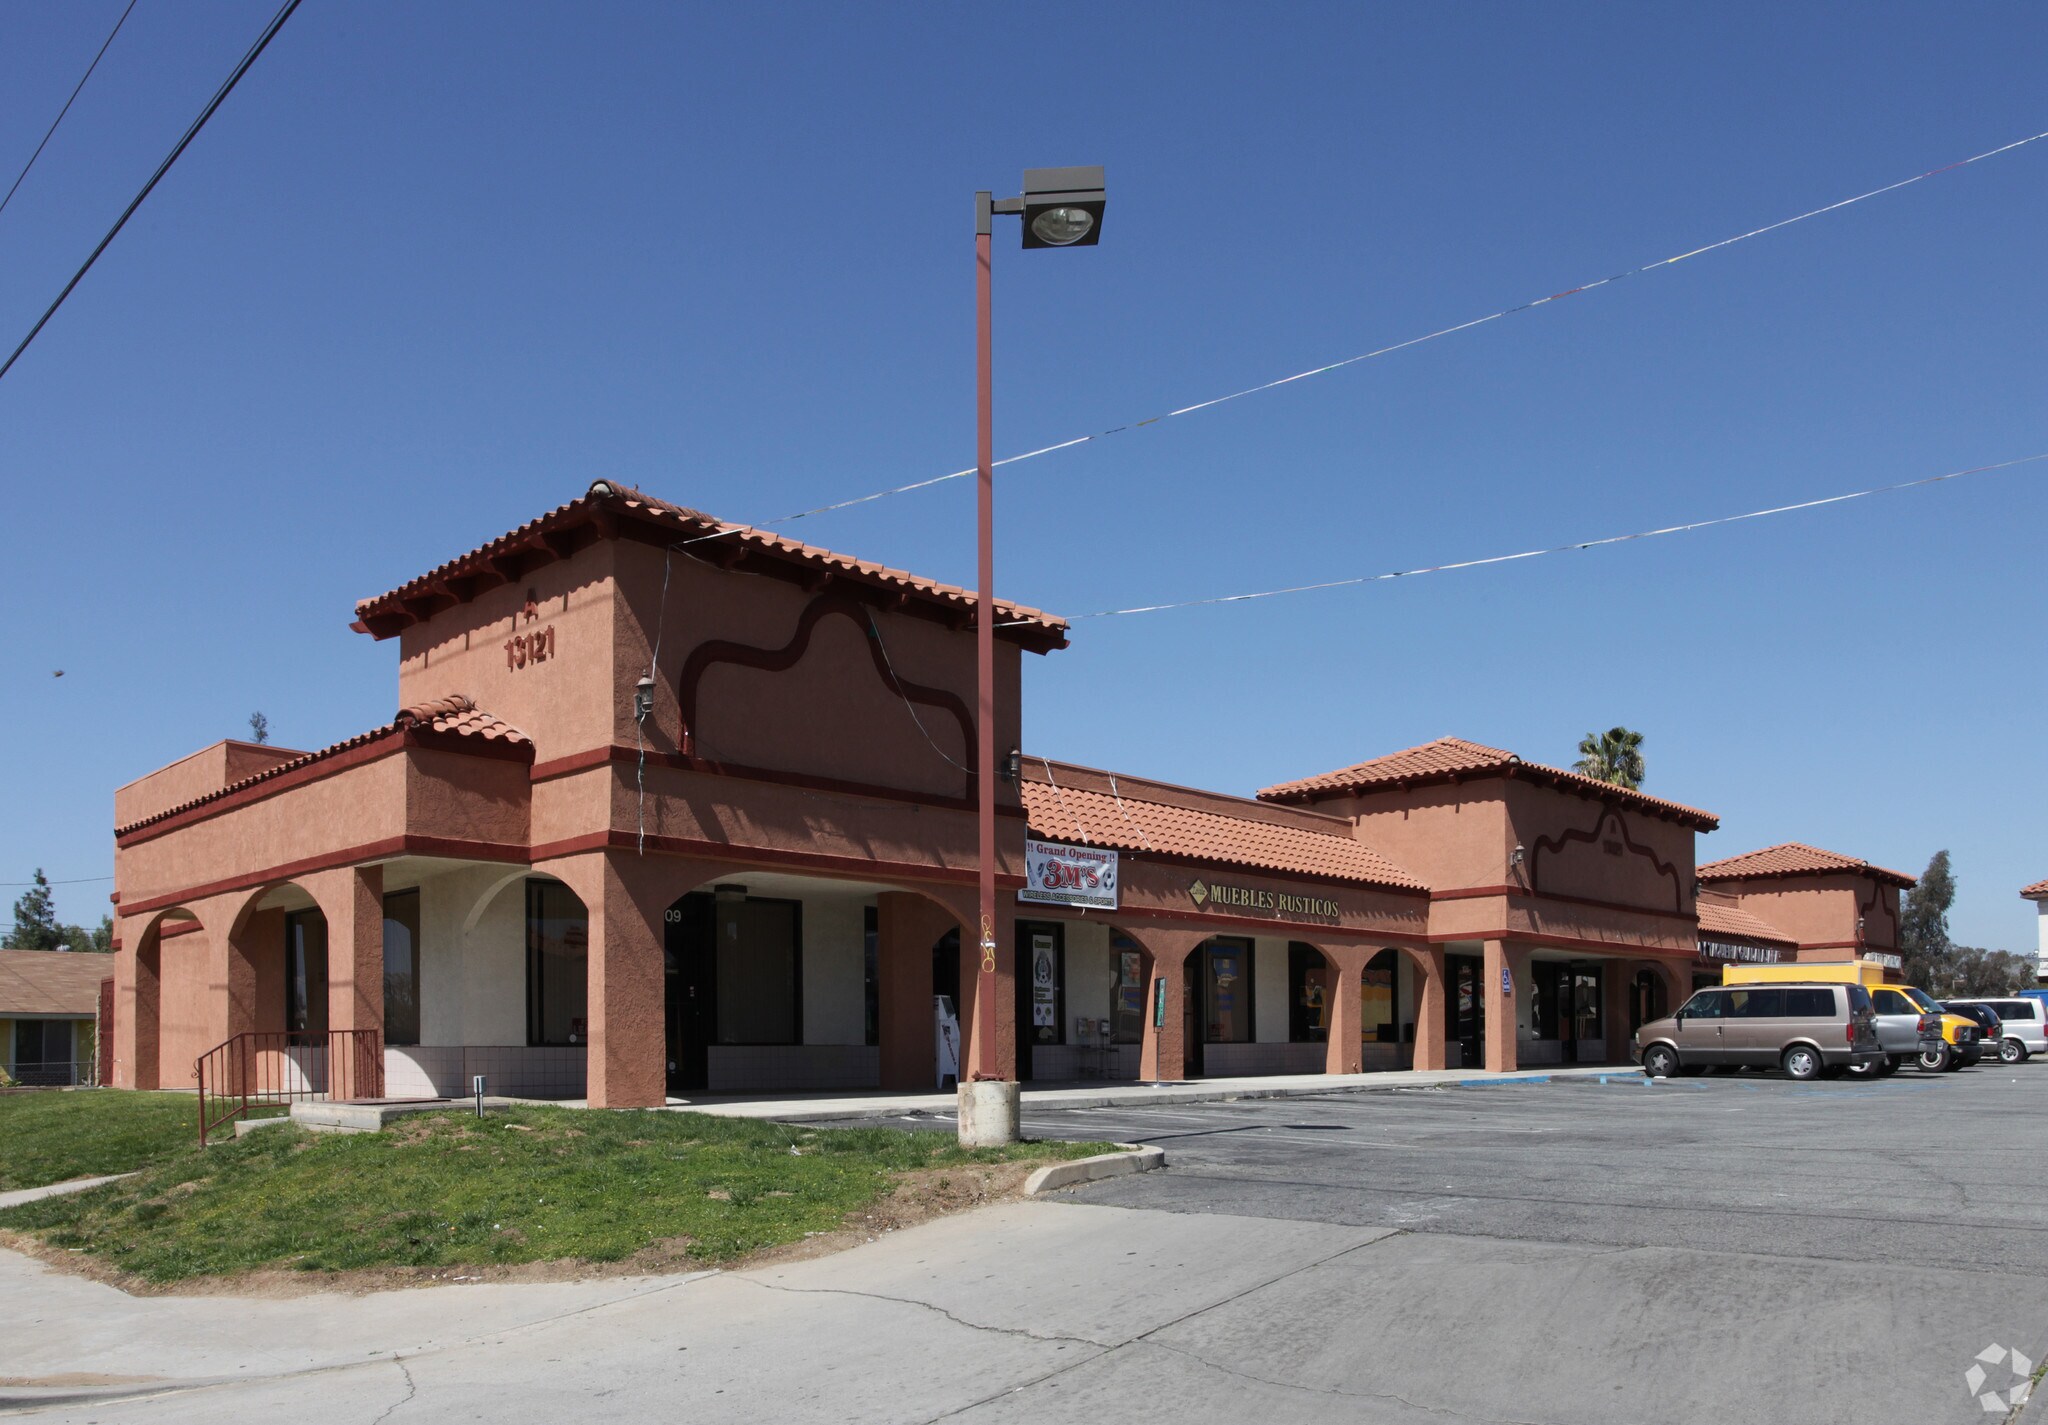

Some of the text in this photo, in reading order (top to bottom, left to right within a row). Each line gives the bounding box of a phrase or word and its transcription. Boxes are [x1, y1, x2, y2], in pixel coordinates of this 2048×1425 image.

[504, 624, 555, 669] 13121
[1036, 844, 1066, 857] Grand
[1069, 848, 1107, 864] Opening
[1022, 890, 1051, 900] WIRELESS
[1052, 893, 1088, 904] ACCESSORIES
[1094, 896, 1115, 906] SPORTS
[1210, 884, 1339, 917] MUEBLES RUSTICOS
